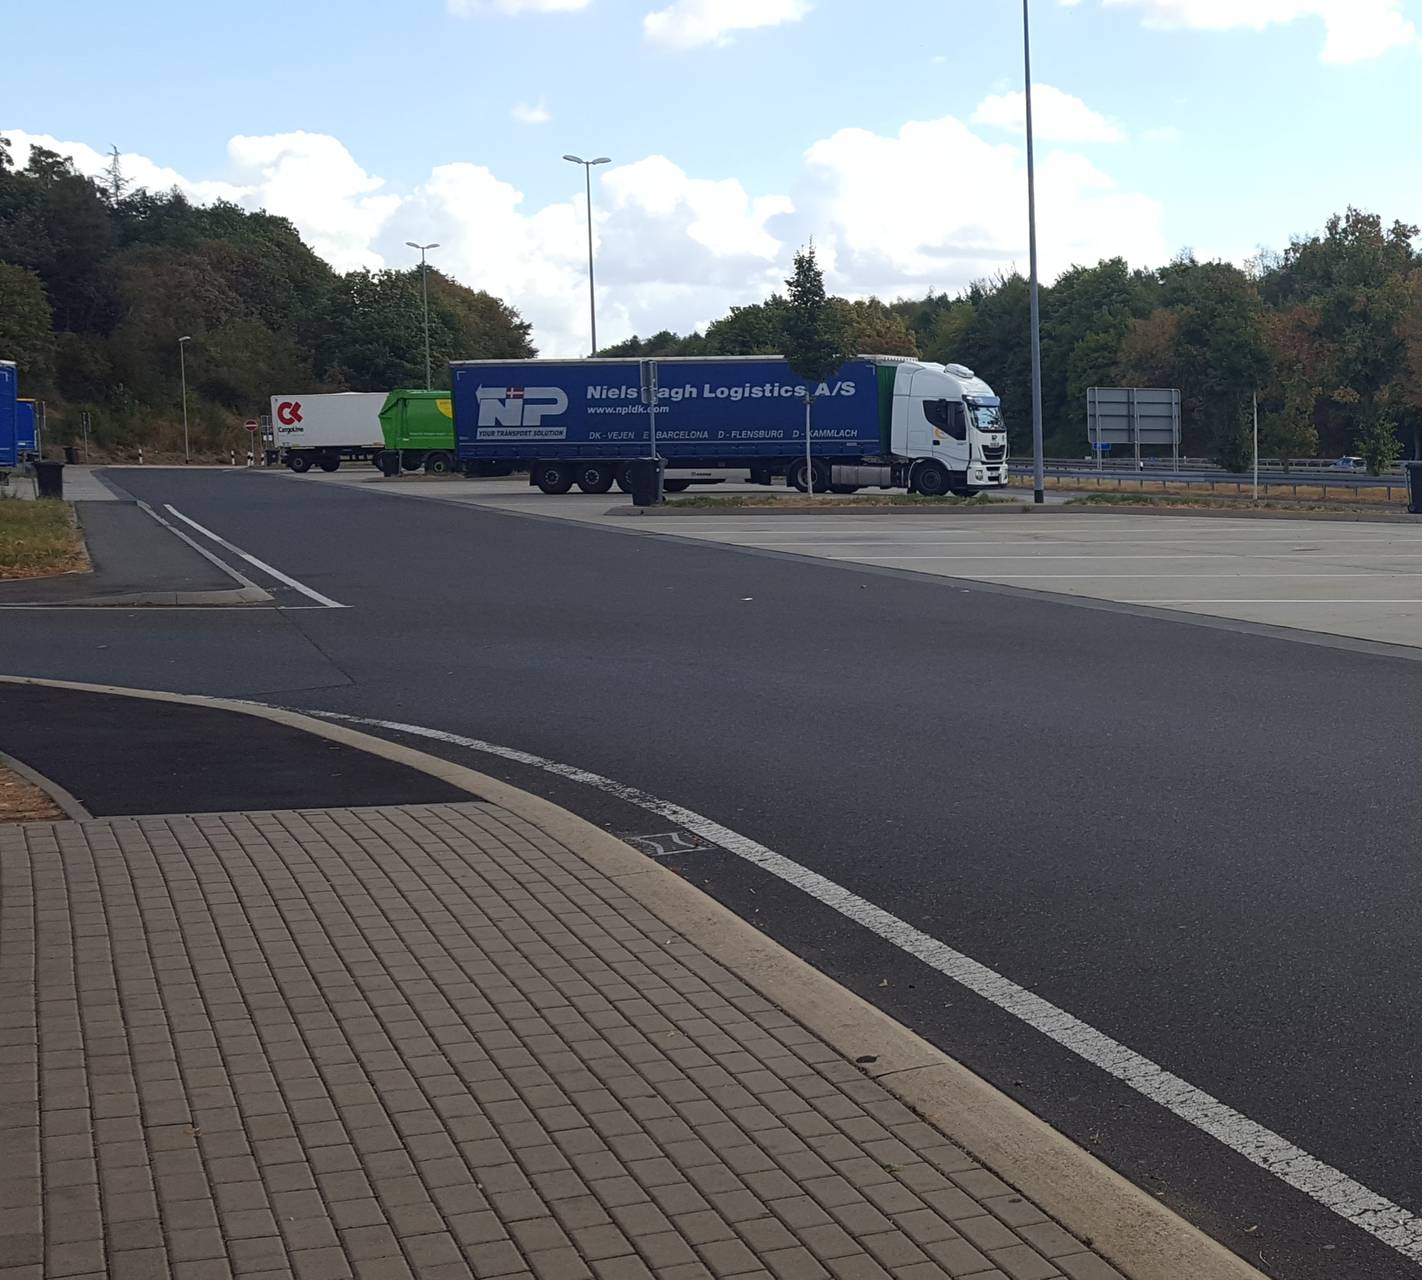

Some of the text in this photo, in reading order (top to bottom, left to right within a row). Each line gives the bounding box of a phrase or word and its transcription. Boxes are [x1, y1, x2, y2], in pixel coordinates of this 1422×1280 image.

[586, 381, 855, 401] Niels agh Logistics A/S
[476, 385, 568, 426] NP
[587, 405, 669, 415] www.npldk.com
[480, 430, 496, 438] YOUR
[656, 430, 709, 439] BARCELONA
[731, 429, 784, 439] FLENSBURG
